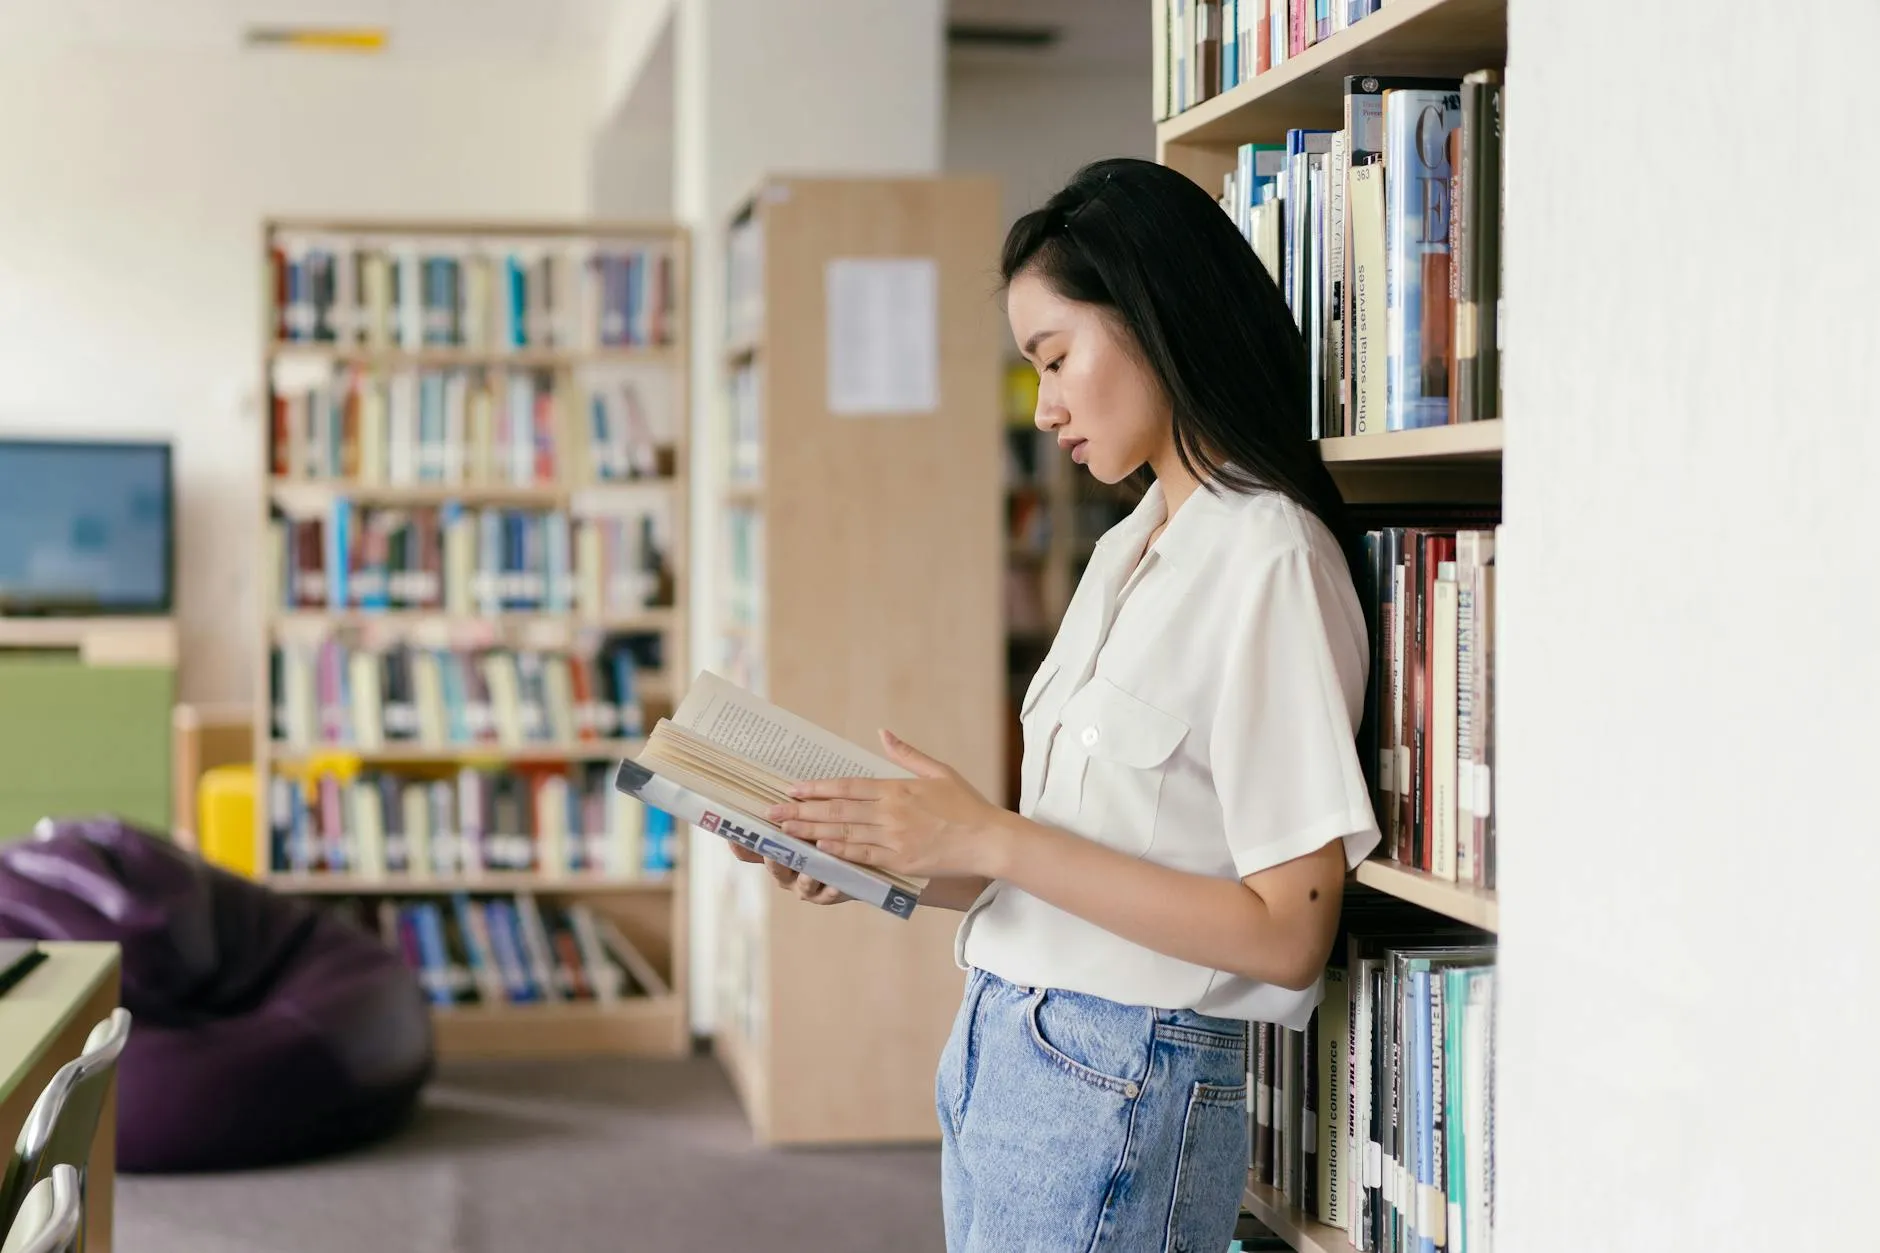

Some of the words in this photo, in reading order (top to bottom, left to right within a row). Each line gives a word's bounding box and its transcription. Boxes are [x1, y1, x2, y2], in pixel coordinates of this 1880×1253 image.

[1356, 168, 1370, 182] 363
[1358, 264, 1367, 331] services
[1358, 336, 1368, 384] social
[1358, 382, 1367, 433] Other
[1330, 1039, 1338, 1121] commerce
[1431, 974, 1442, 1126] INTERNATIONAL
[1328, 1125, 1337, 1222] International
